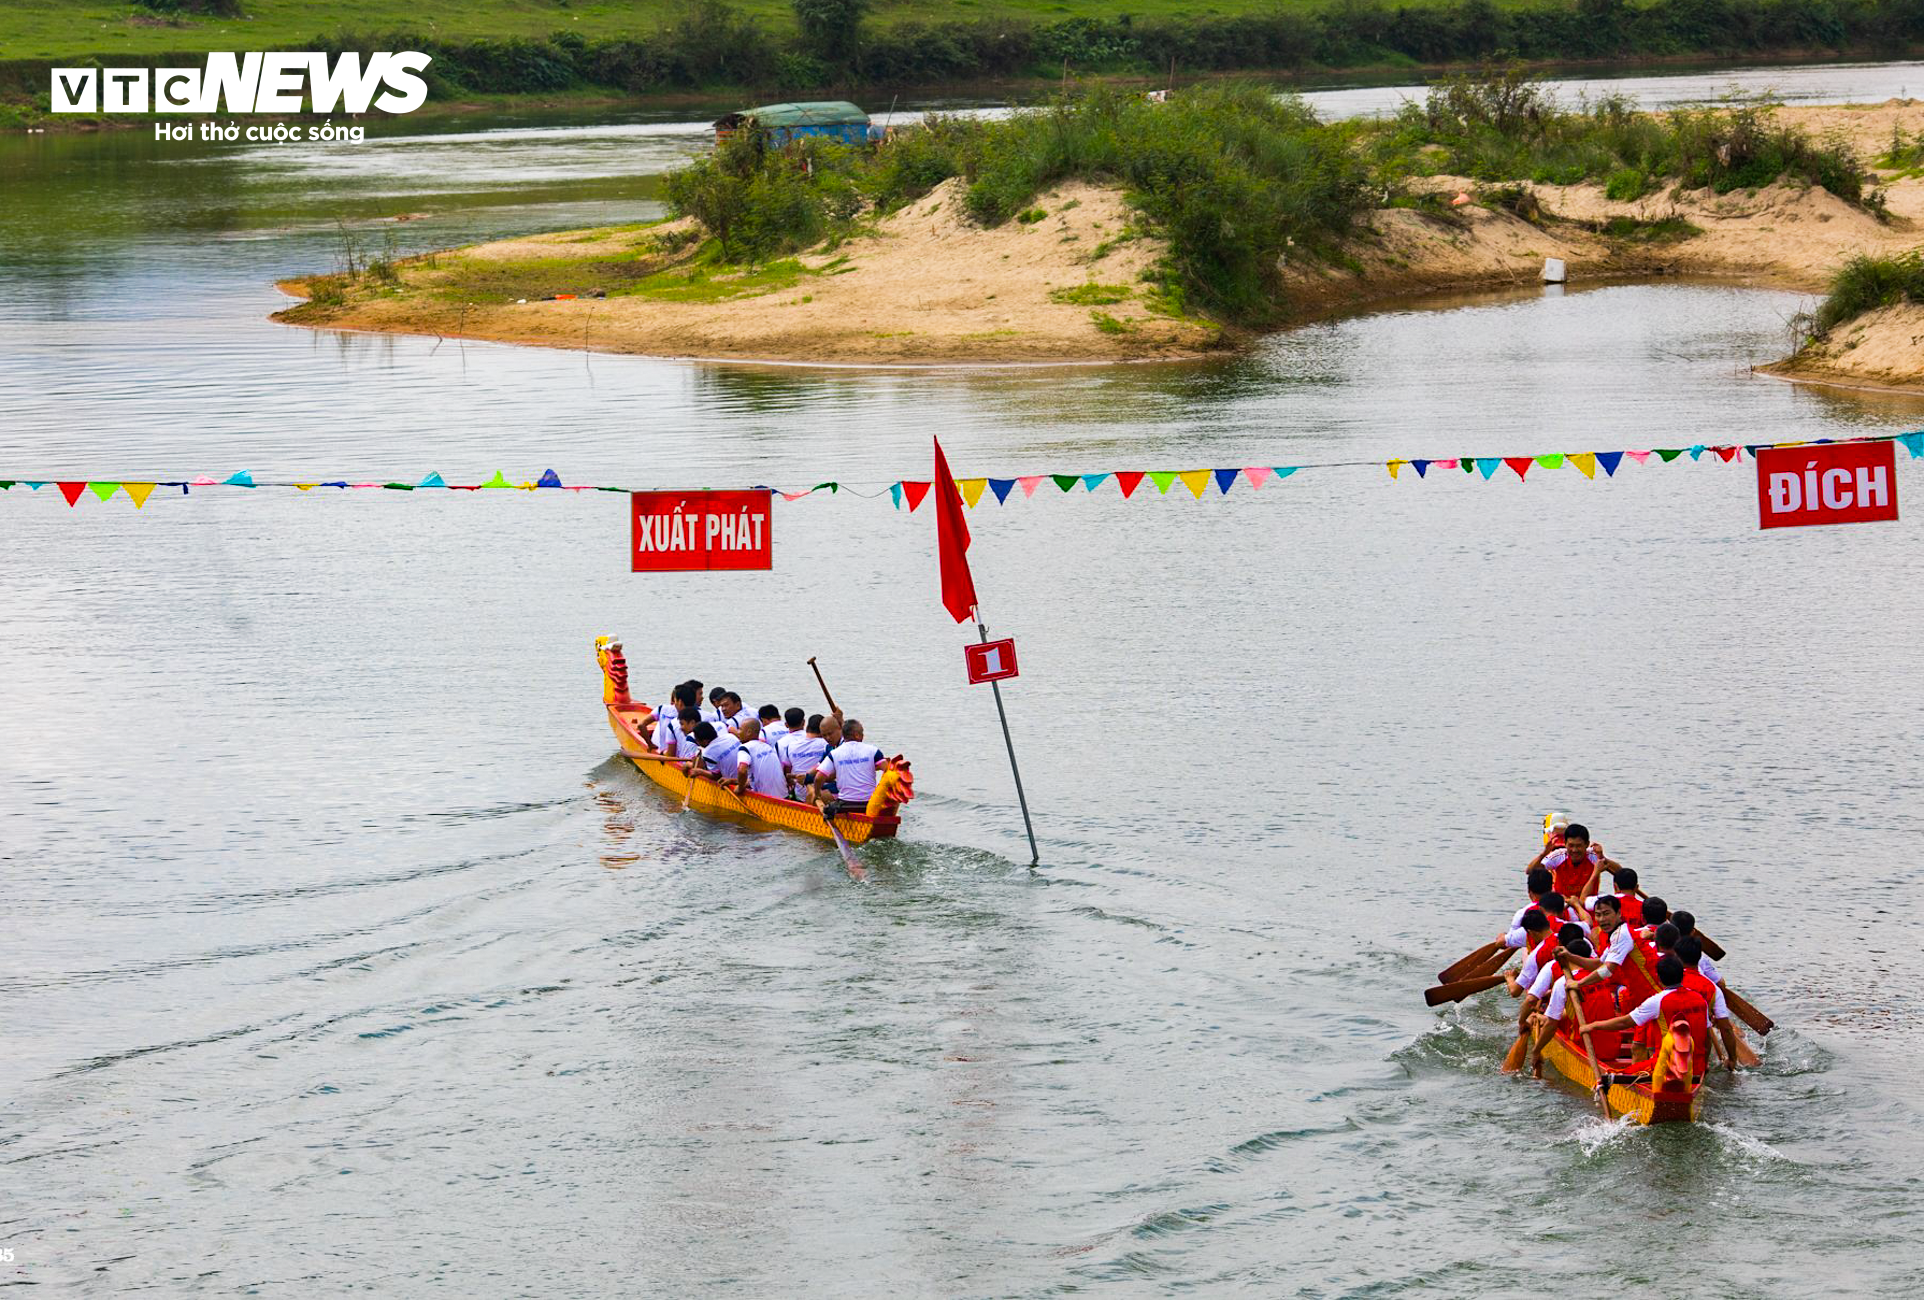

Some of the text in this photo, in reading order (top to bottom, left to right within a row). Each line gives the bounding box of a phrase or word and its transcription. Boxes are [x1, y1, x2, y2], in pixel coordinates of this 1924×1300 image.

[1768, 460, 1888, 514] ĐÍCH
[638, 500, 765, 552] XUẤT PHÁT
[977, 646, 1009, 676] 1
